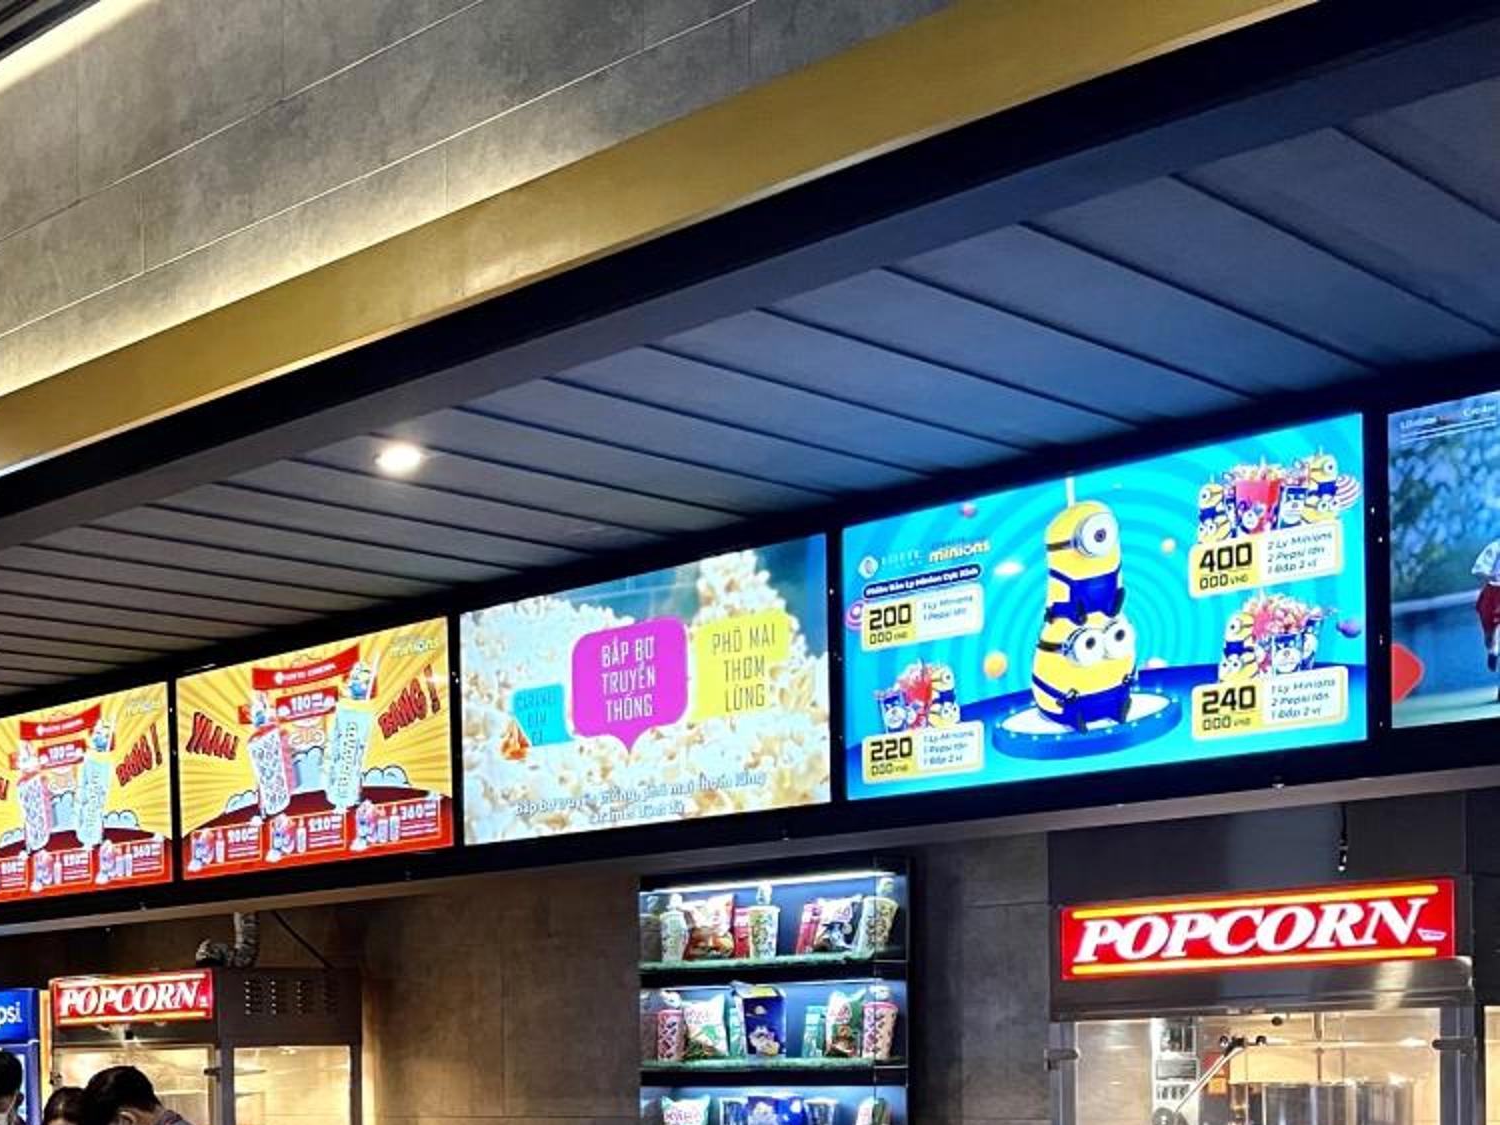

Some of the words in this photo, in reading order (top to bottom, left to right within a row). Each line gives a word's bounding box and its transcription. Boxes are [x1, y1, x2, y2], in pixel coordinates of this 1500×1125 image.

[1200, 541, 1253, 573] 400
[1200, 573, 1229, 590] 000
[869, 603, 912, 631] 200
[749, 622, 776, 650] MAI
[1202, 685, 1257, 715] 240
[869, 736, 913, 762] 220
[1073, 898, 1429, 964] POPCORN
[59, 980, 200, 1017] POPCORN
